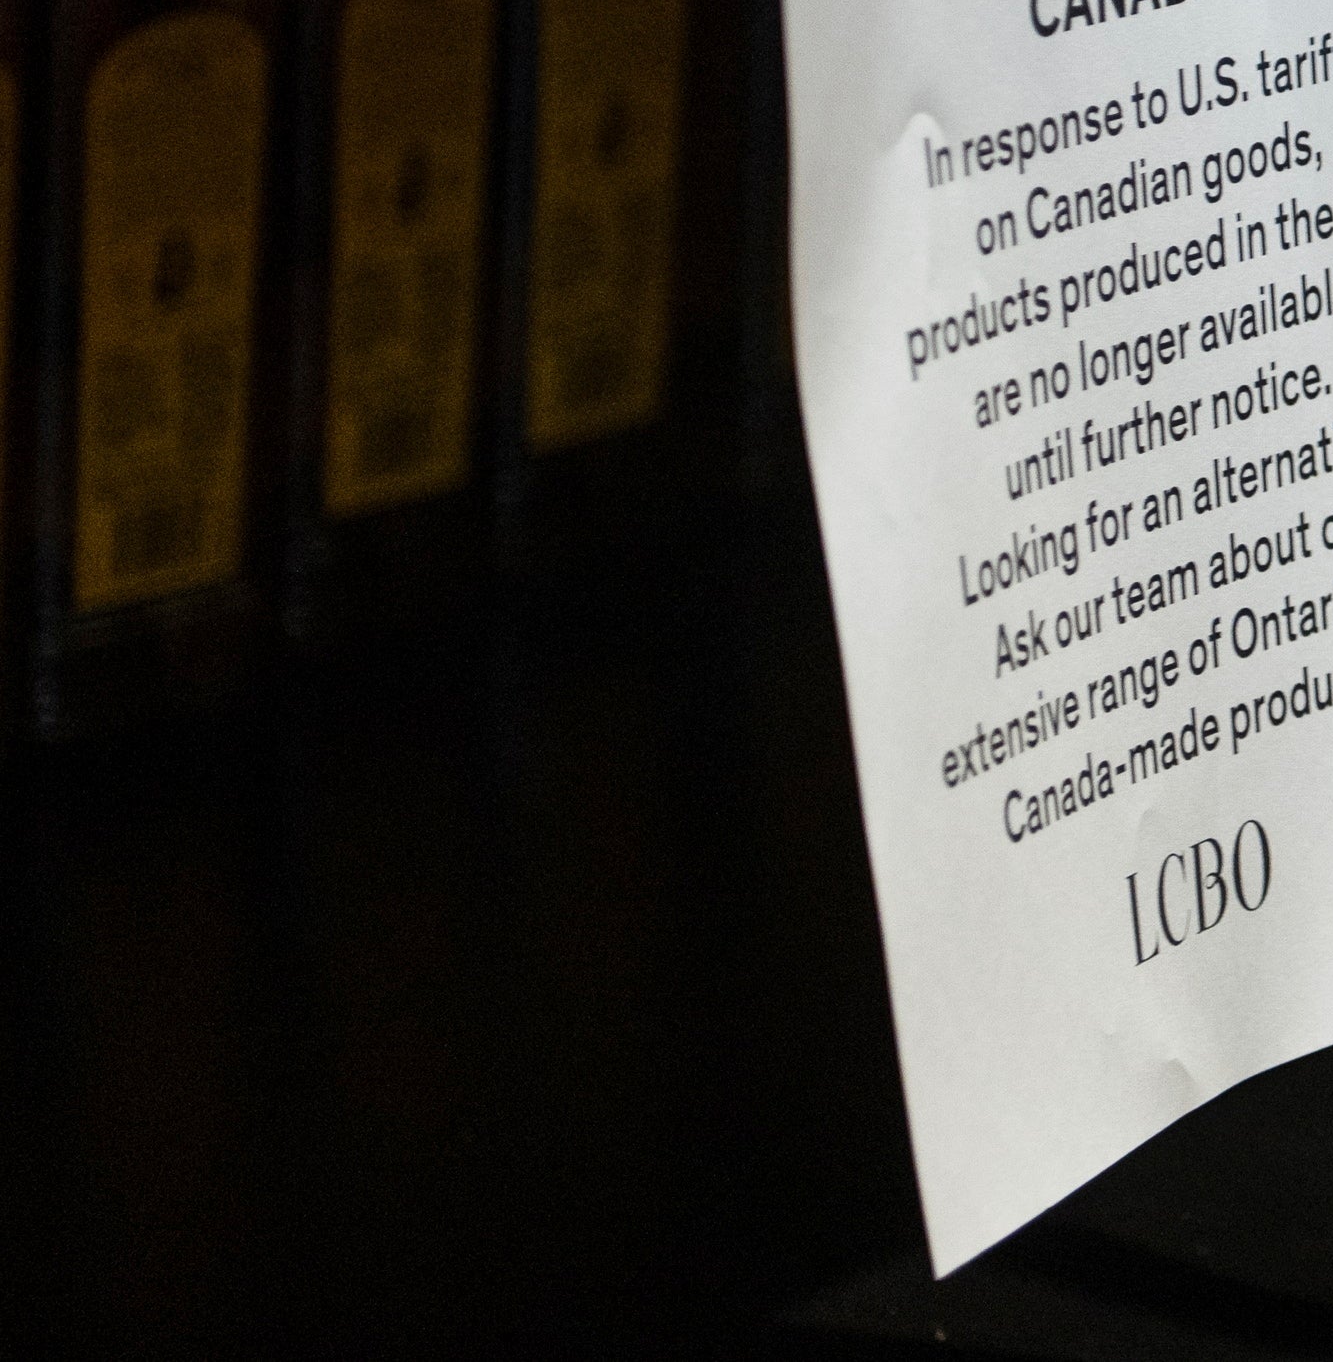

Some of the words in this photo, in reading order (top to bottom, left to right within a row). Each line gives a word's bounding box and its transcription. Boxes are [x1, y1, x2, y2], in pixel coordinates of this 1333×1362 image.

[925, 139, 954, 188] In
[962, 99, 1124, 176] response
[1130, 81, 1169, 129] to
[1178, 56, 1249, 117] U.S.
[976, 210, 1018, 256] on
[1026, 158, 1192, 240] Canadian
[1202, 120, 1323, 204] goods,
[906, 278, 1051, 381] products
[1060, 217, 1227, 328] produced
[1236, 212, 1267, 262] in
[975, 378, 1022, 429] are
[1029, 361, 1071, 407] no
[1079, 322, 1191, 391] longer
[1006, 427, 1074, 501] until
[1081, 398, 1202, 472] further
[1211, 361, 1332, 429] notice.
[959, 523, 1080, 607] Looking
[1085, 500, 1134, 552] for
[1142, 486, 1183, 533] an
[996, 610, 1050, 679] Ask
[1055, 595, 1105, 648] our
[1111, 561, 1200, 625] team
[1209, 511, 1312, 589] about
[941, 691, 1080, 789] extensive
[1087, 649, 1180, 719] range
[1188, 617, 1222, 676] of
[1003, 707, 1221, 844] Canada-made
[1126, 819, 1272, 966] LCBO
